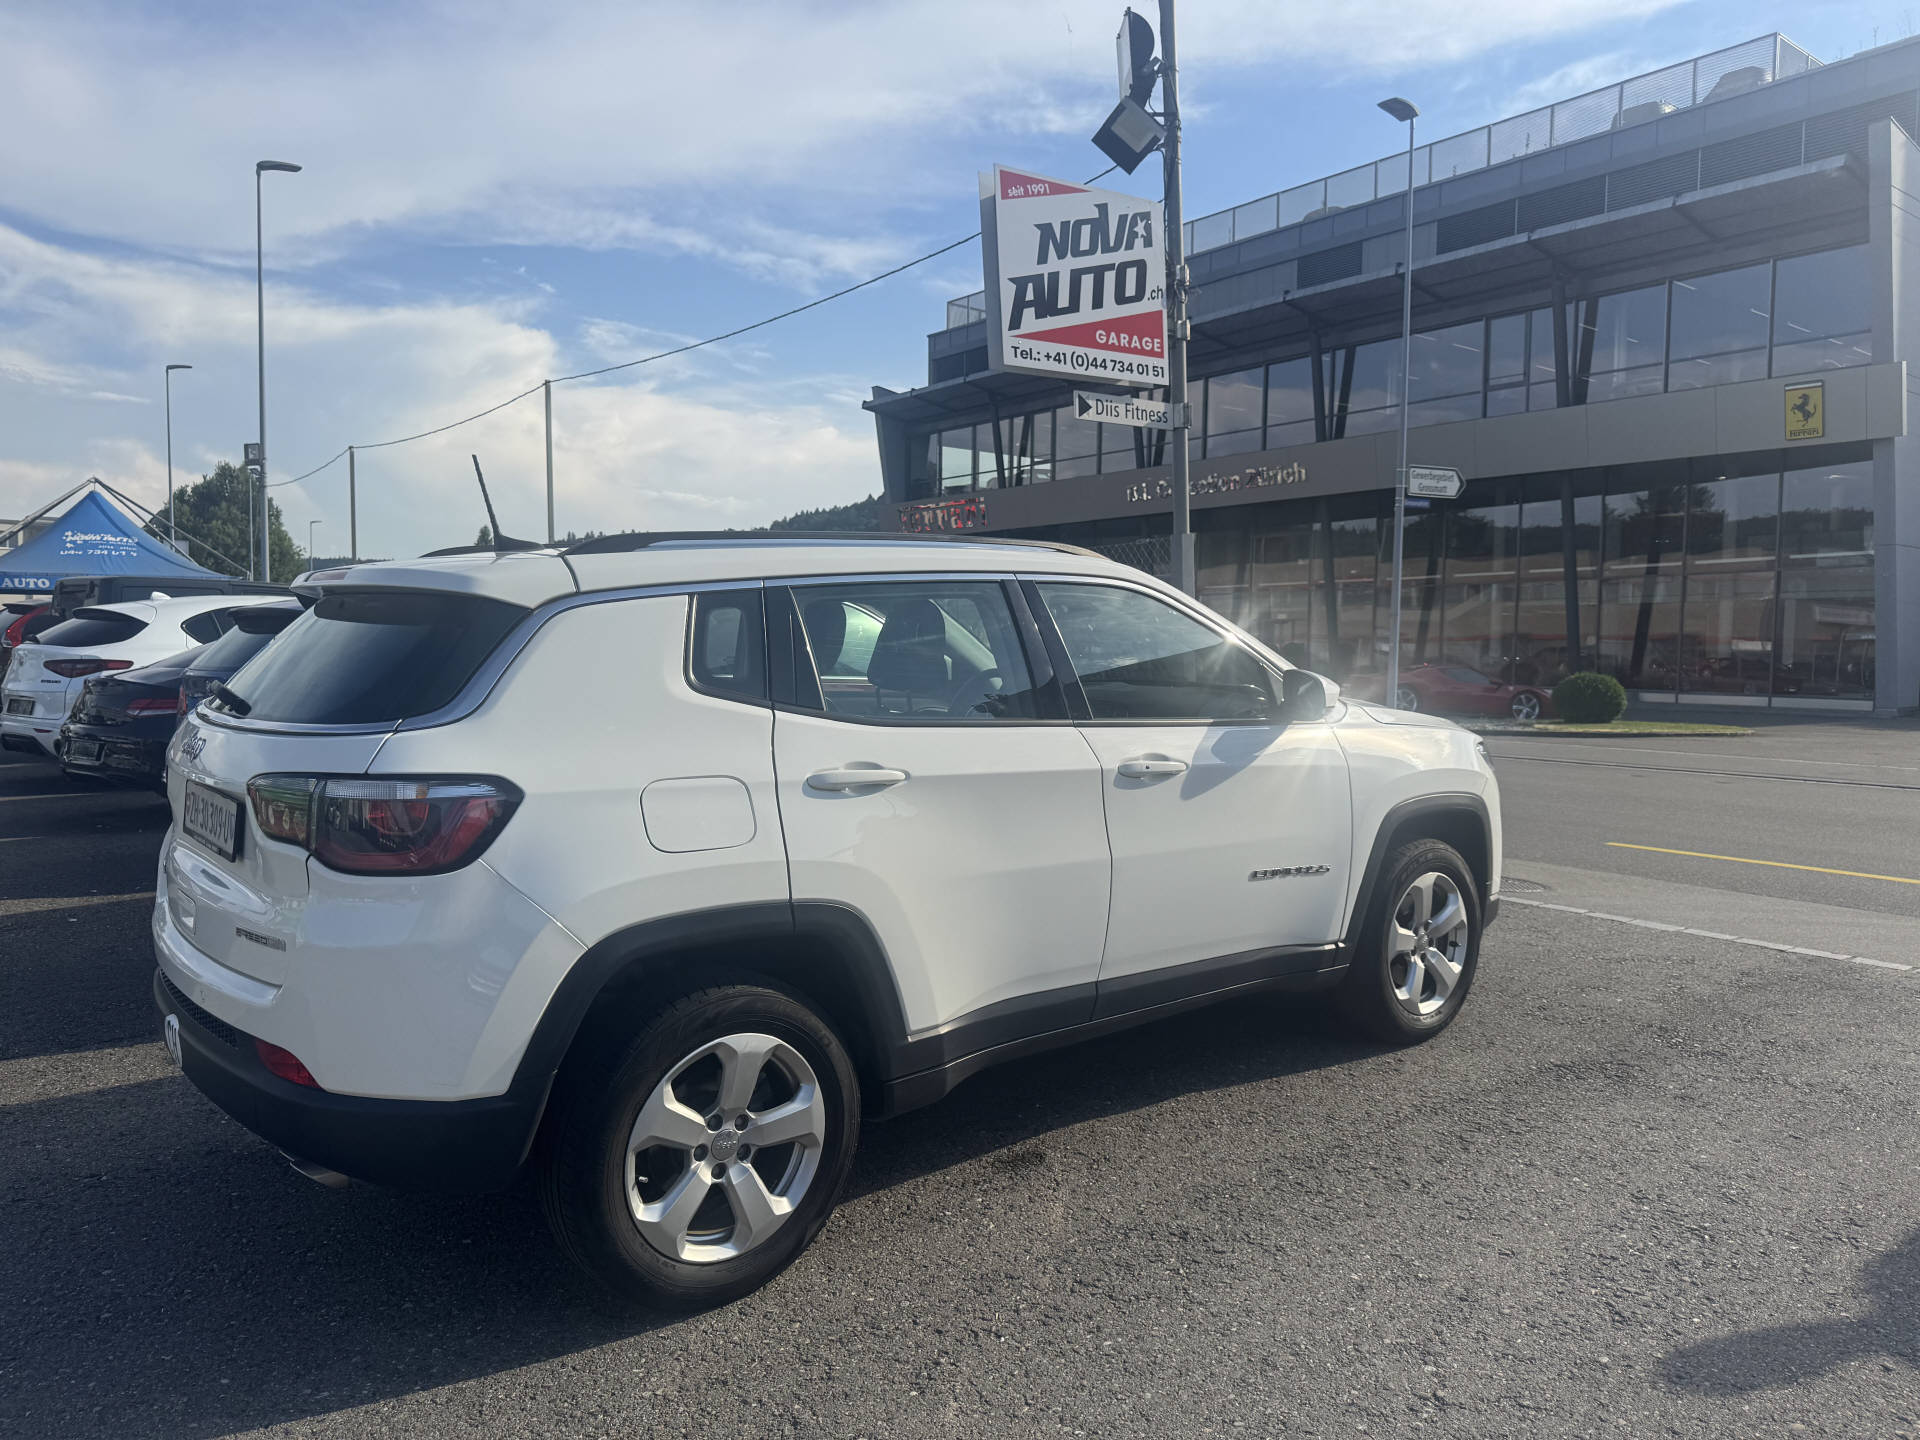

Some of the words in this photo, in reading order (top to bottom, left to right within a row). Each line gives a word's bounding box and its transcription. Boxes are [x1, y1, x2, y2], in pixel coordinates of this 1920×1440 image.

[1007, 185, 1025, 197] seit
[1027, 183, 1051, 195] 1991
[1033, 202, 1153, 266] NOVA
[1007, 259, 1148, 332] AUTO
[1095, 329, 1162, 353] GARAGE
[1011, 345, 1041, 362] Tel.:
[1044, 351, 1067, 365] +41
[1070, 351, 1107, 371] (0)44
[1110, 359, 1134, 374] 734
[1136, 363, 1149, 376] 01
[1152, 365, 1165, 378] 51
[1095, 398, 1120, 418] Diis
[1125, 402, 1169, 424] Fitness
[1245, 461, 1307, 489] Zürich
[1, 577, 50, 589] AUTO
